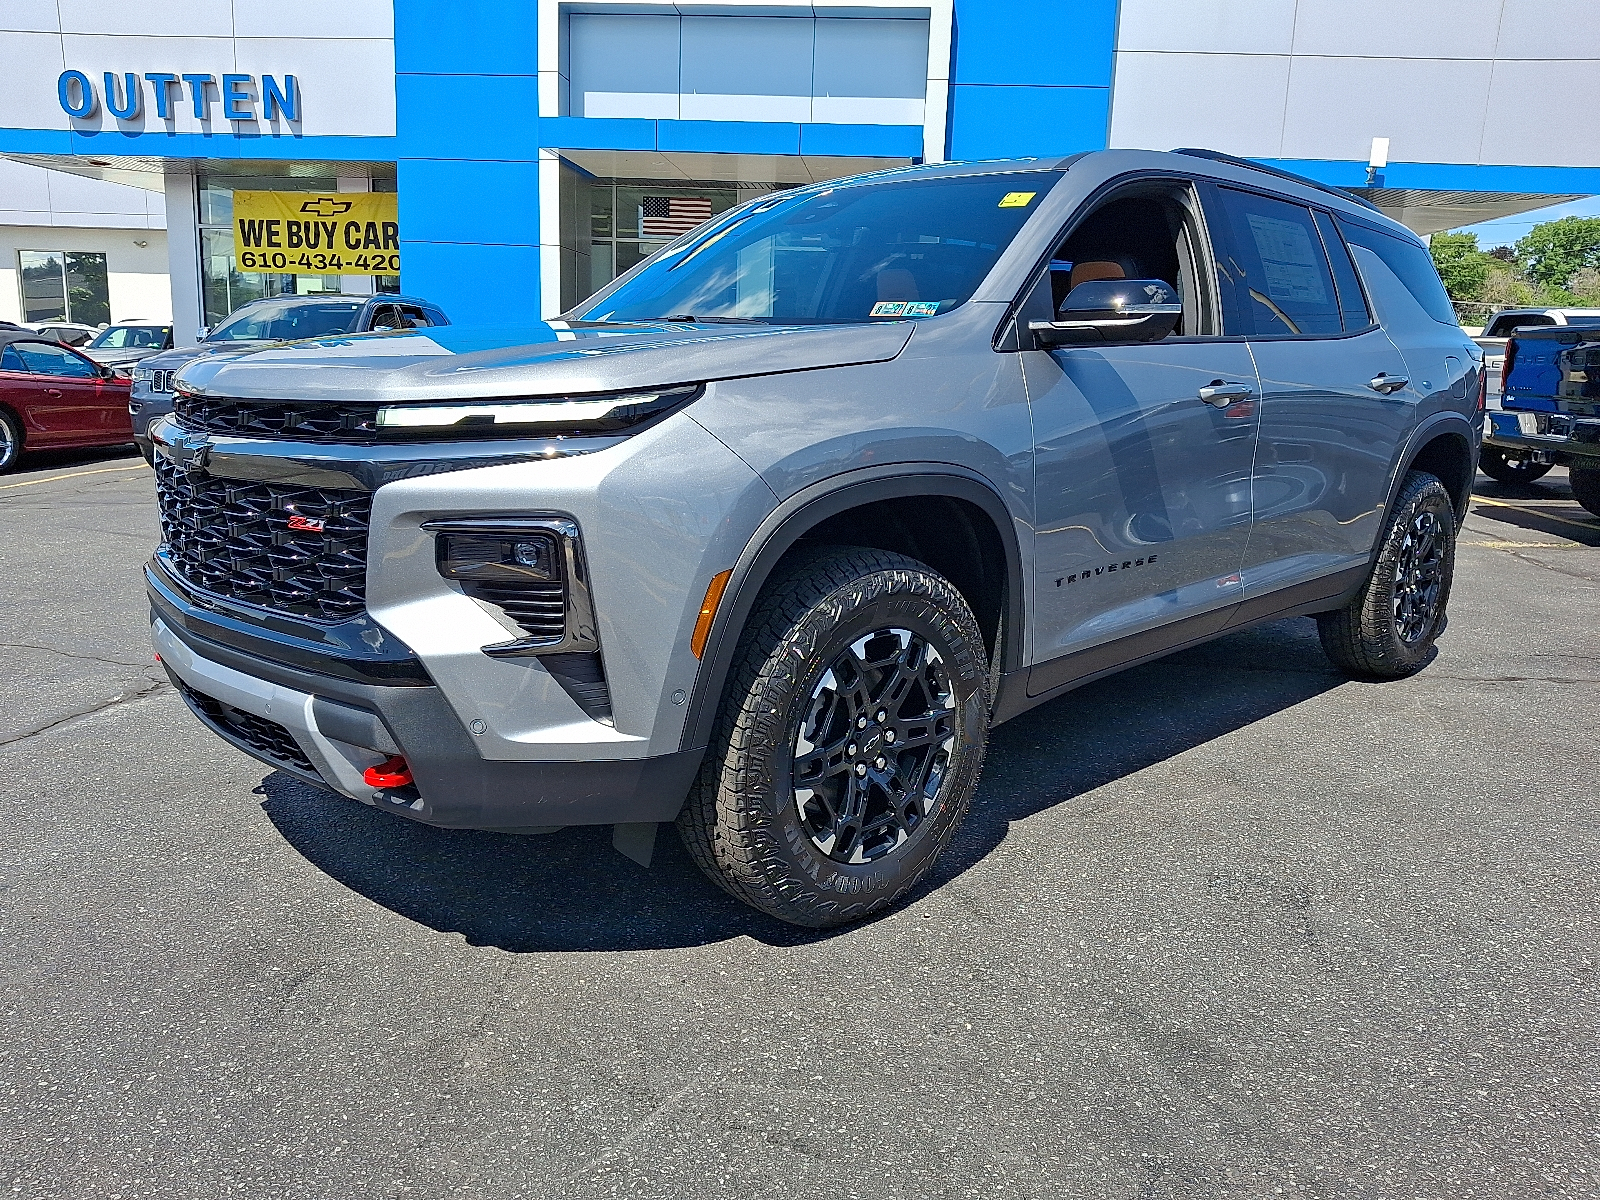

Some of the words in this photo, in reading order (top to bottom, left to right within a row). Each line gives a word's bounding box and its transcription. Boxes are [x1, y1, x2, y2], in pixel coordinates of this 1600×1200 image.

[57, 69, 298, 121] OUTTEN
[238, 218, 282, 248] WE
[286, 219, 338, 250] BUY
[287, 515, 325, 532] Z71
[1054, 555, 1158, 588] TRAVERSE
